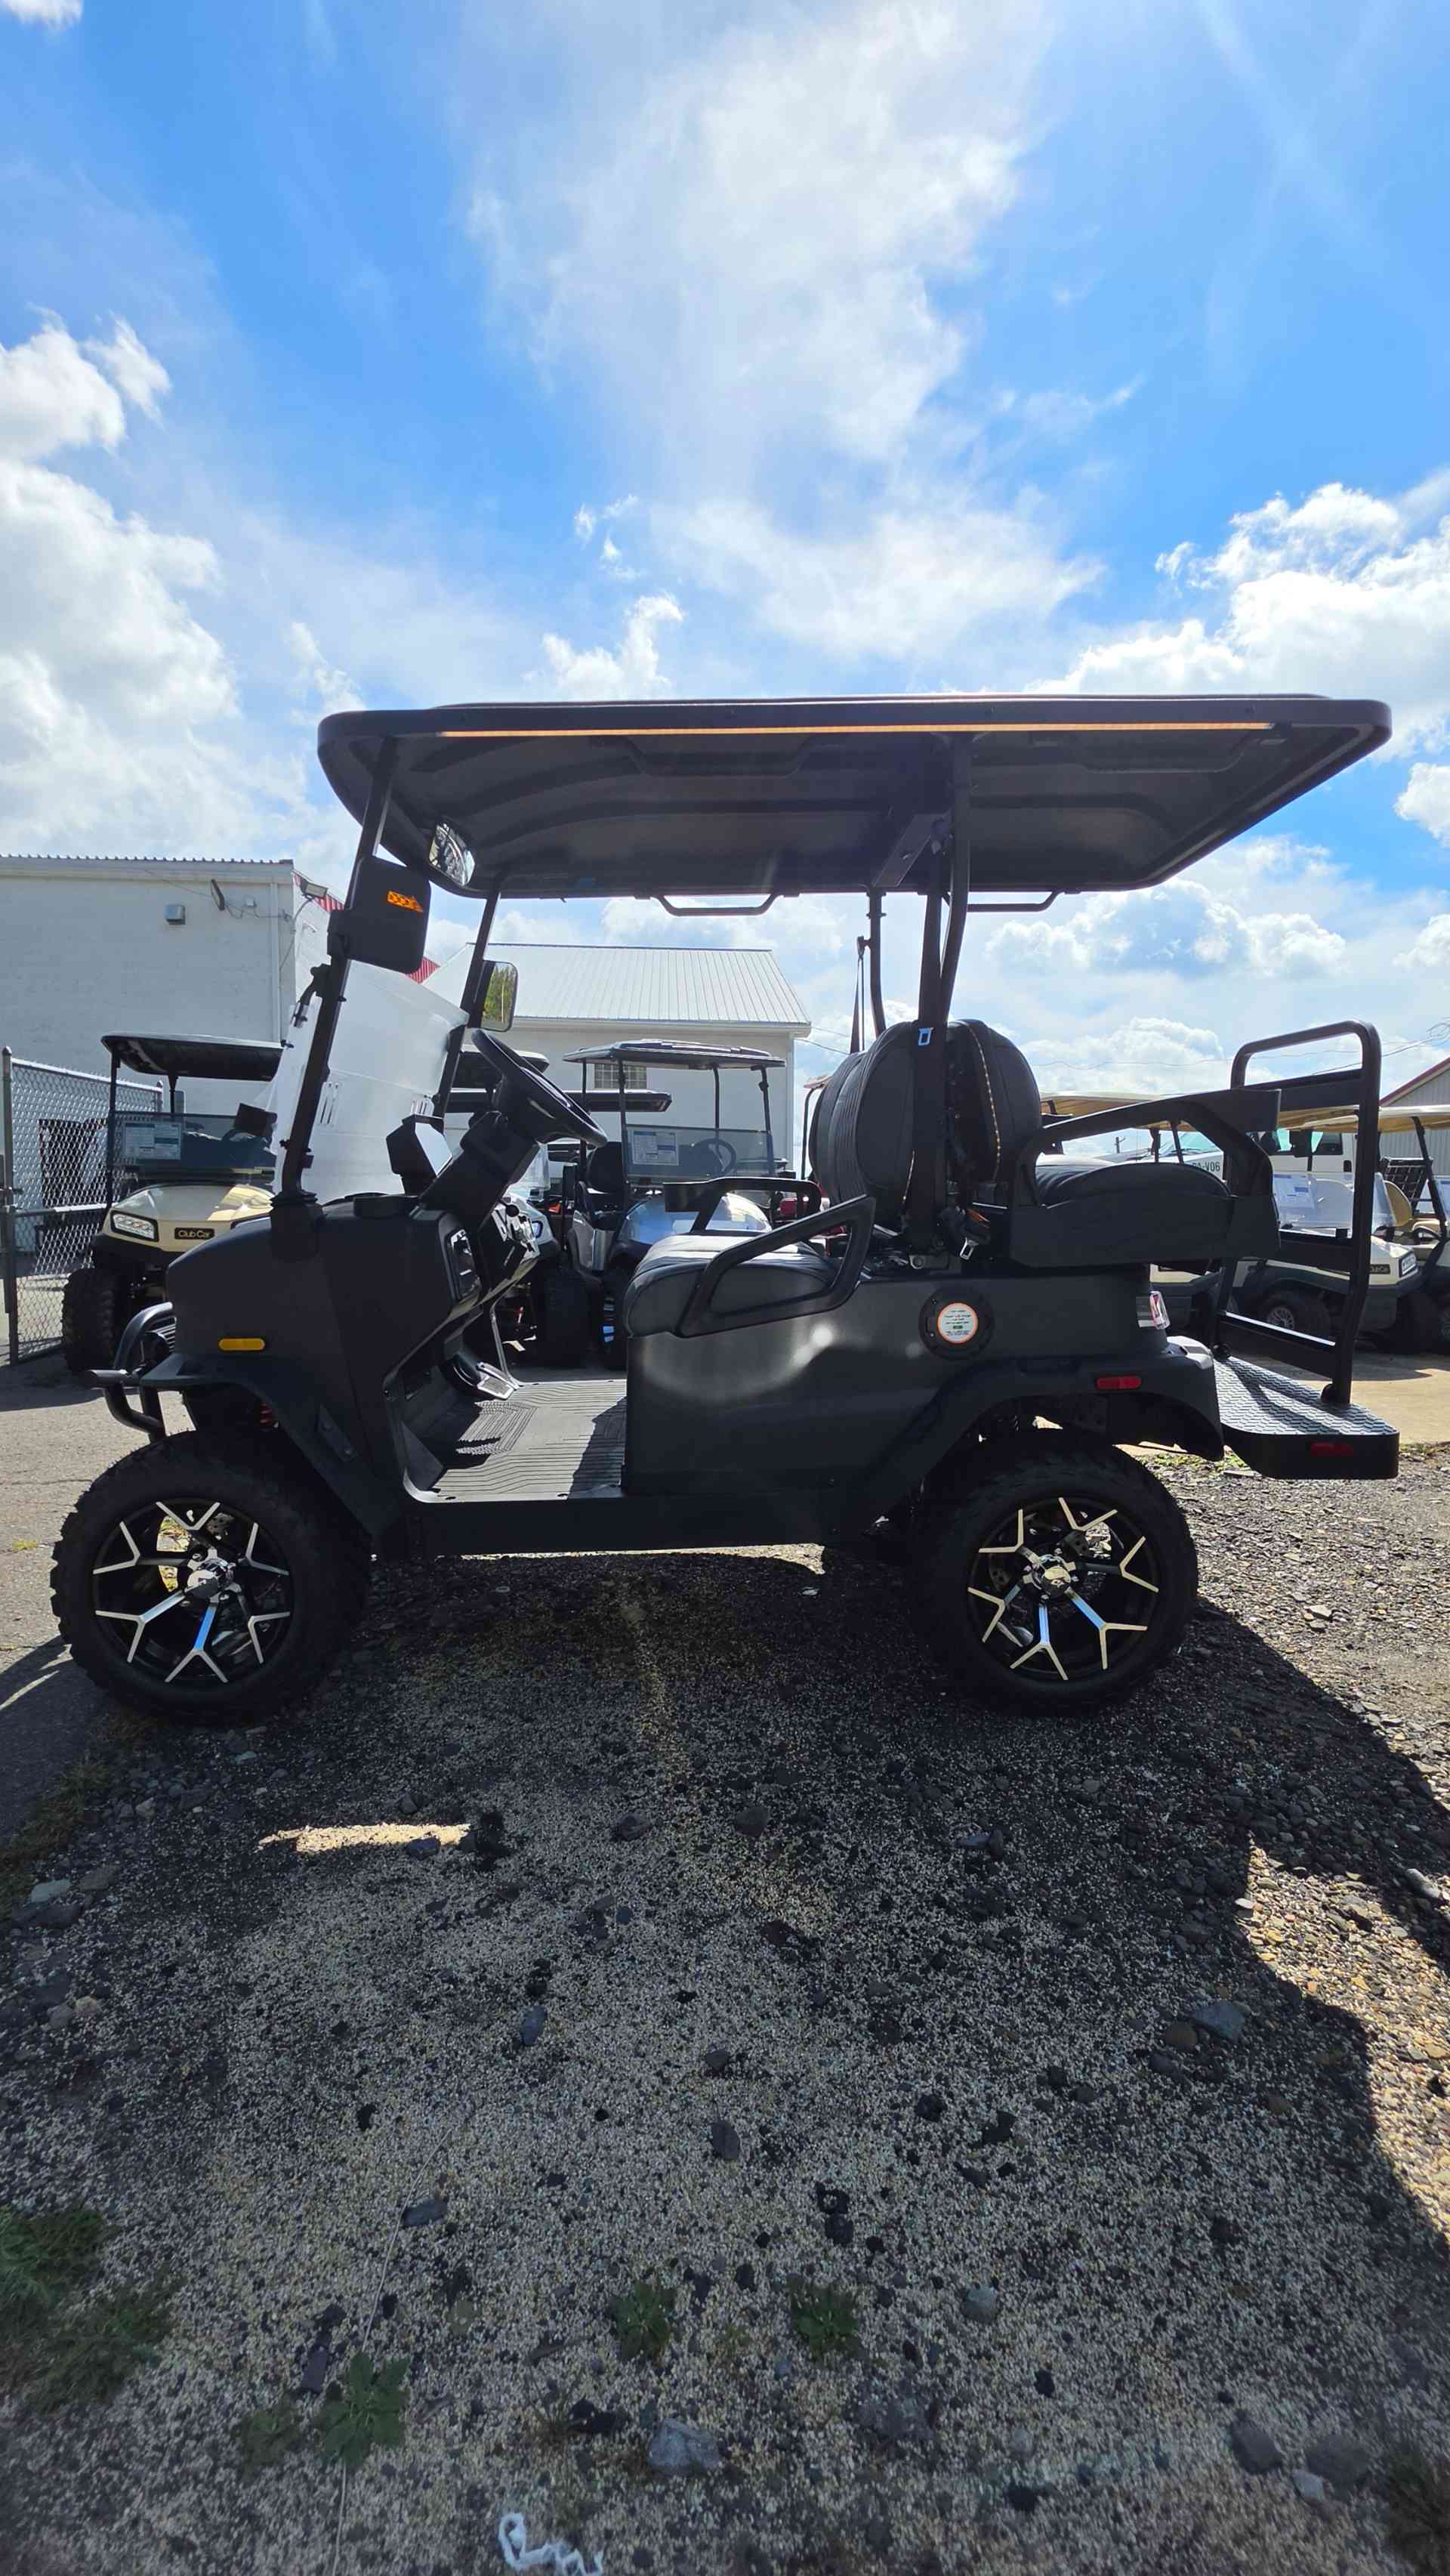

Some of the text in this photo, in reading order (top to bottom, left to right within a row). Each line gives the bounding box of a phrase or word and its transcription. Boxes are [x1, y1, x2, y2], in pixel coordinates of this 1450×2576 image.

[1192, 1160, 1220, 1172] A-V06
[178, 1230, 211, 1239] Club Car
